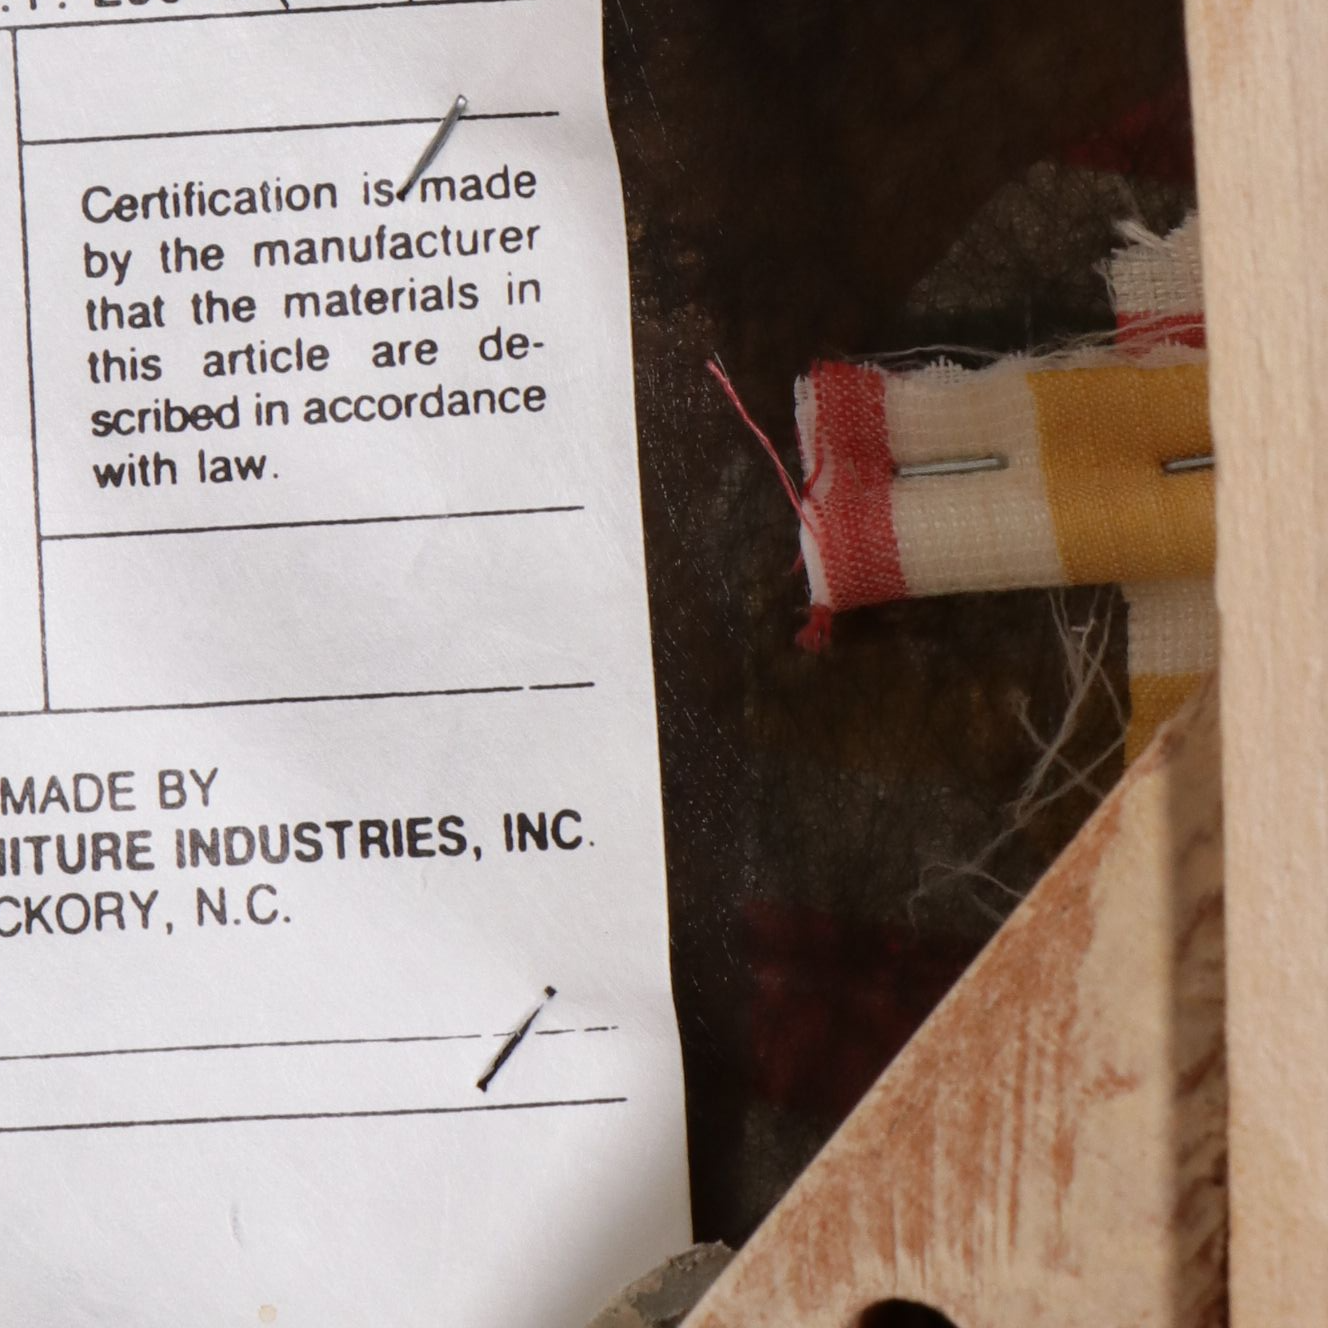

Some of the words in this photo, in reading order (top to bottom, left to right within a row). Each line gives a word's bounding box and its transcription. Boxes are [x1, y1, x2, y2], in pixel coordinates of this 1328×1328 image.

[82, 177, 337, 223] Certification
[364, 172, 394, 207] is
[421, 164, 536, 202] made
[84, 242, 132, 286] by
[160, 237, 224, 273] the
[254, 224, 540, 267] manufacturer
[86, 295, 165, 331] that
[191, 290, 256, 325] the
[285, 276, 479, 318] materials
[508, 272, 540, 305] in
[88, 347, 162, 384] this
[203, 338, 329, 377] article
[372, 339, 438, 368] are
[479, 326, 544, 361] de-
[91, 395, 240, 437] scribed
[255, 393, 289, 426] in
[304, 384, 546, 425] accordance
[93, 452, 177, 488] with
[198, 449, 278, 483] law.
[0, 771, 136, 815] MADE
[159, 768, 218, 809] BY
[176, 815, 481, 869] INDUSTRIES,
[504, 809, 594, 852] INC.
[197, 884, 290, 926] N.C.
